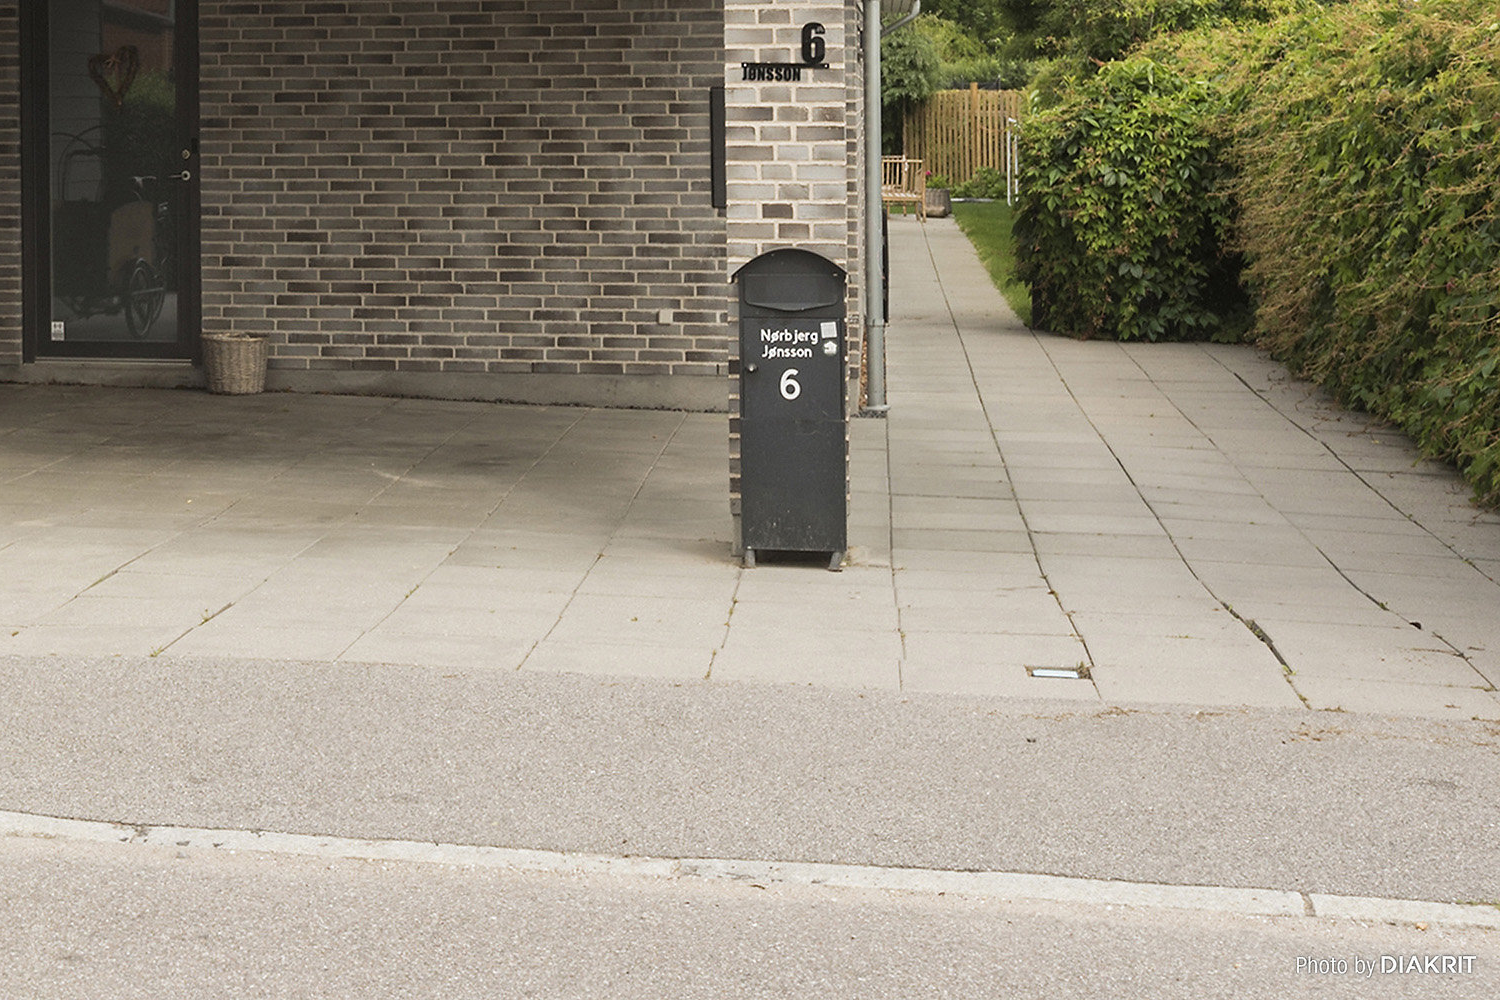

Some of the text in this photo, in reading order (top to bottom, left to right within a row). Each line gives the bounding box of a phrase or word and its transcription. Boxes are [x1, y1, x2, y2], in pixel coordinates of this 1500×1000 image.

[801, 22, 826, 64] 6
[741, 66, 801, 82] JØNSSON
[760, 328, 819, 345] Nørbjerg
[761, 344, 813, 359] Jønsson
[780, 368, 801, 400] 6
